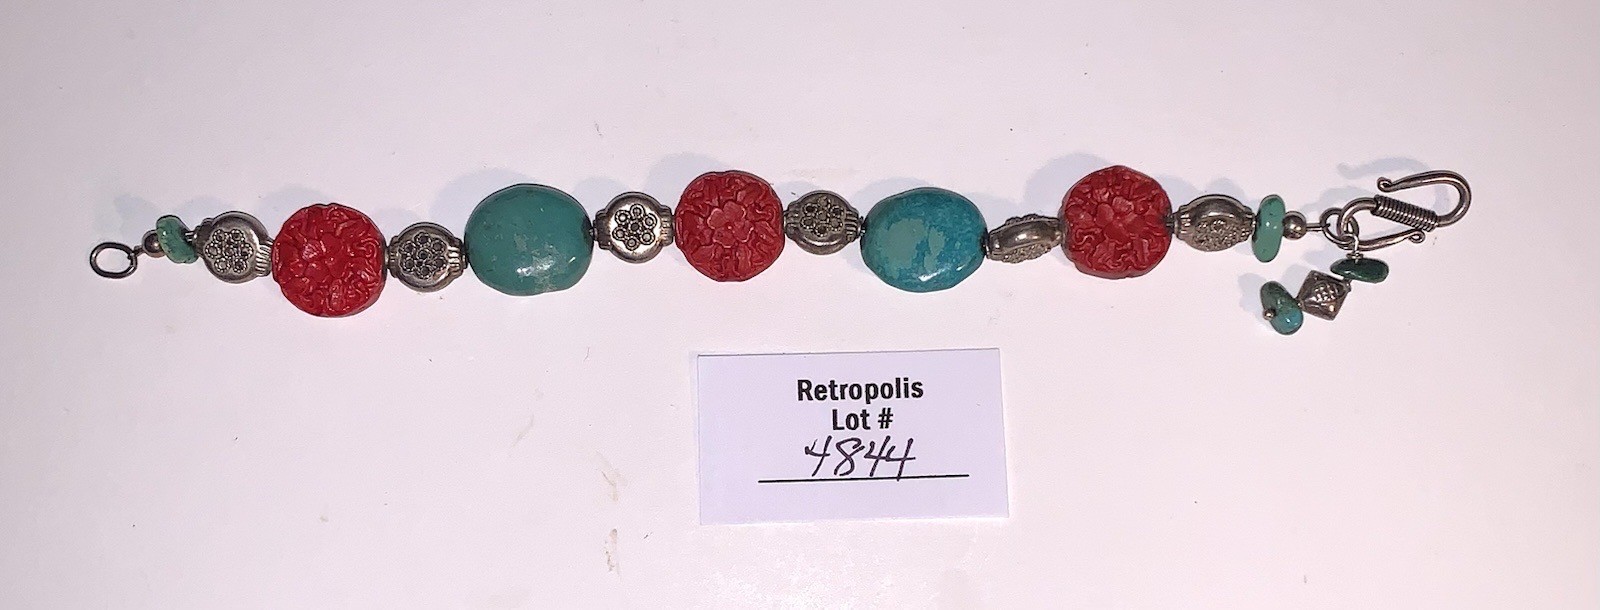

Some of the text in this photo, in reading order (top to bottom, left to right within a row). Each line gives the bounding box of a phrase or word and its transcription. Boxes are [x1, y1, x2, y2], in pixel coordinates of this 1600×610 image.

[797, 377, 924, 404] Retropolis
[832, 407, 894, 431] Lot #
[804, 435, 916, 481] 4844
